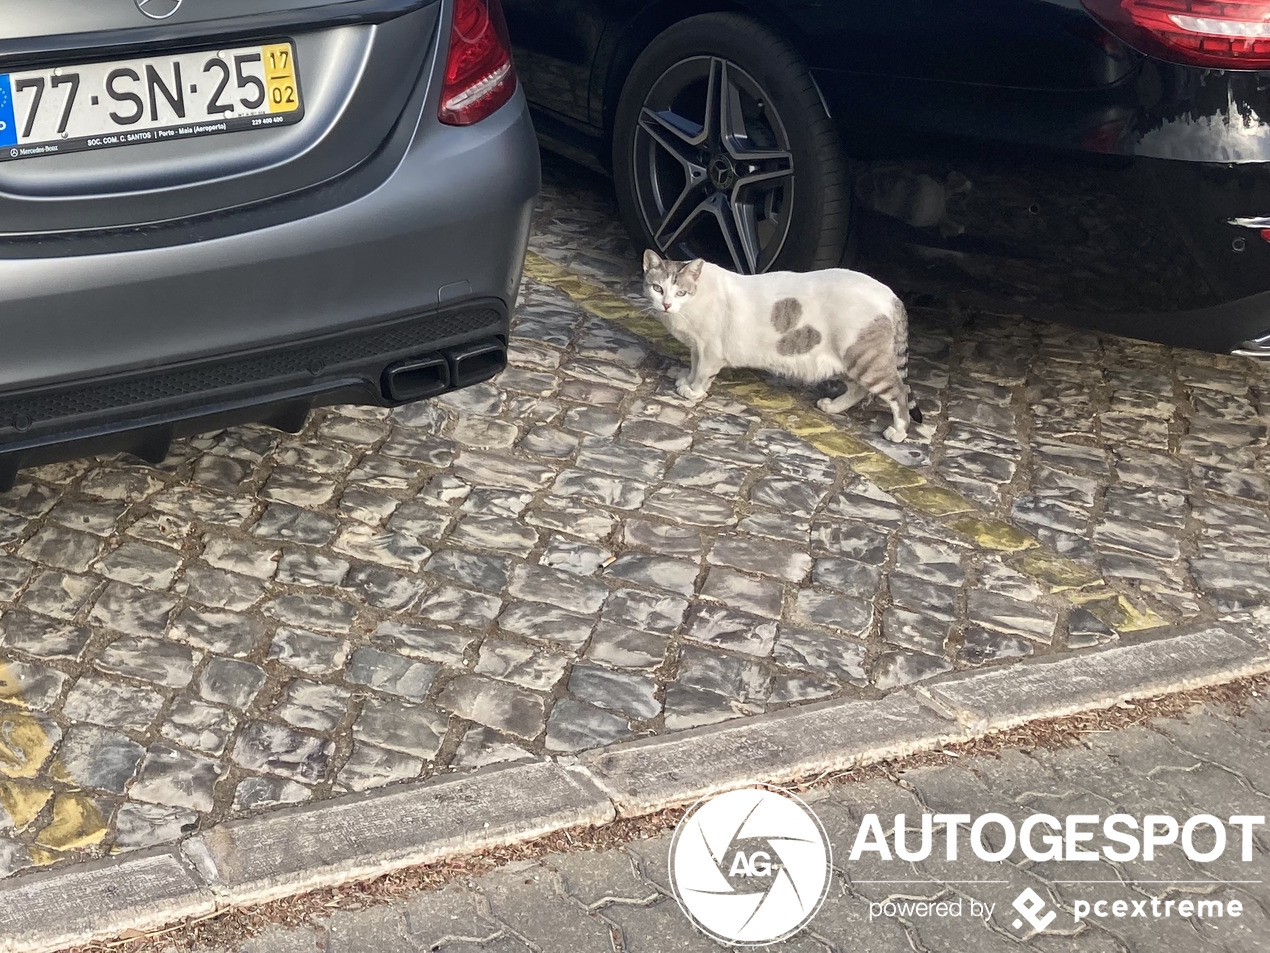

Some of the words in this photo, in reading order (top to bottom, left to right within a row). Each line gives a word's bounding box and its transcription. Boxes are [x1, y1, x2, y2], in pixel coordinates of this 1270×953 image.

[268, 50, 289, 70] 17
[272, 85, 295, 105] 02
[158, 129, 175, 138] Porto
[178, 127, 193, 135] Maia
[193, 123, 227, 134] (Aeroporto)
[87, 137, 103, 146] SOC.
[127, 132, 151, 141] SANTOS
[19, 144, 59, 156] Mercedes-Benz
